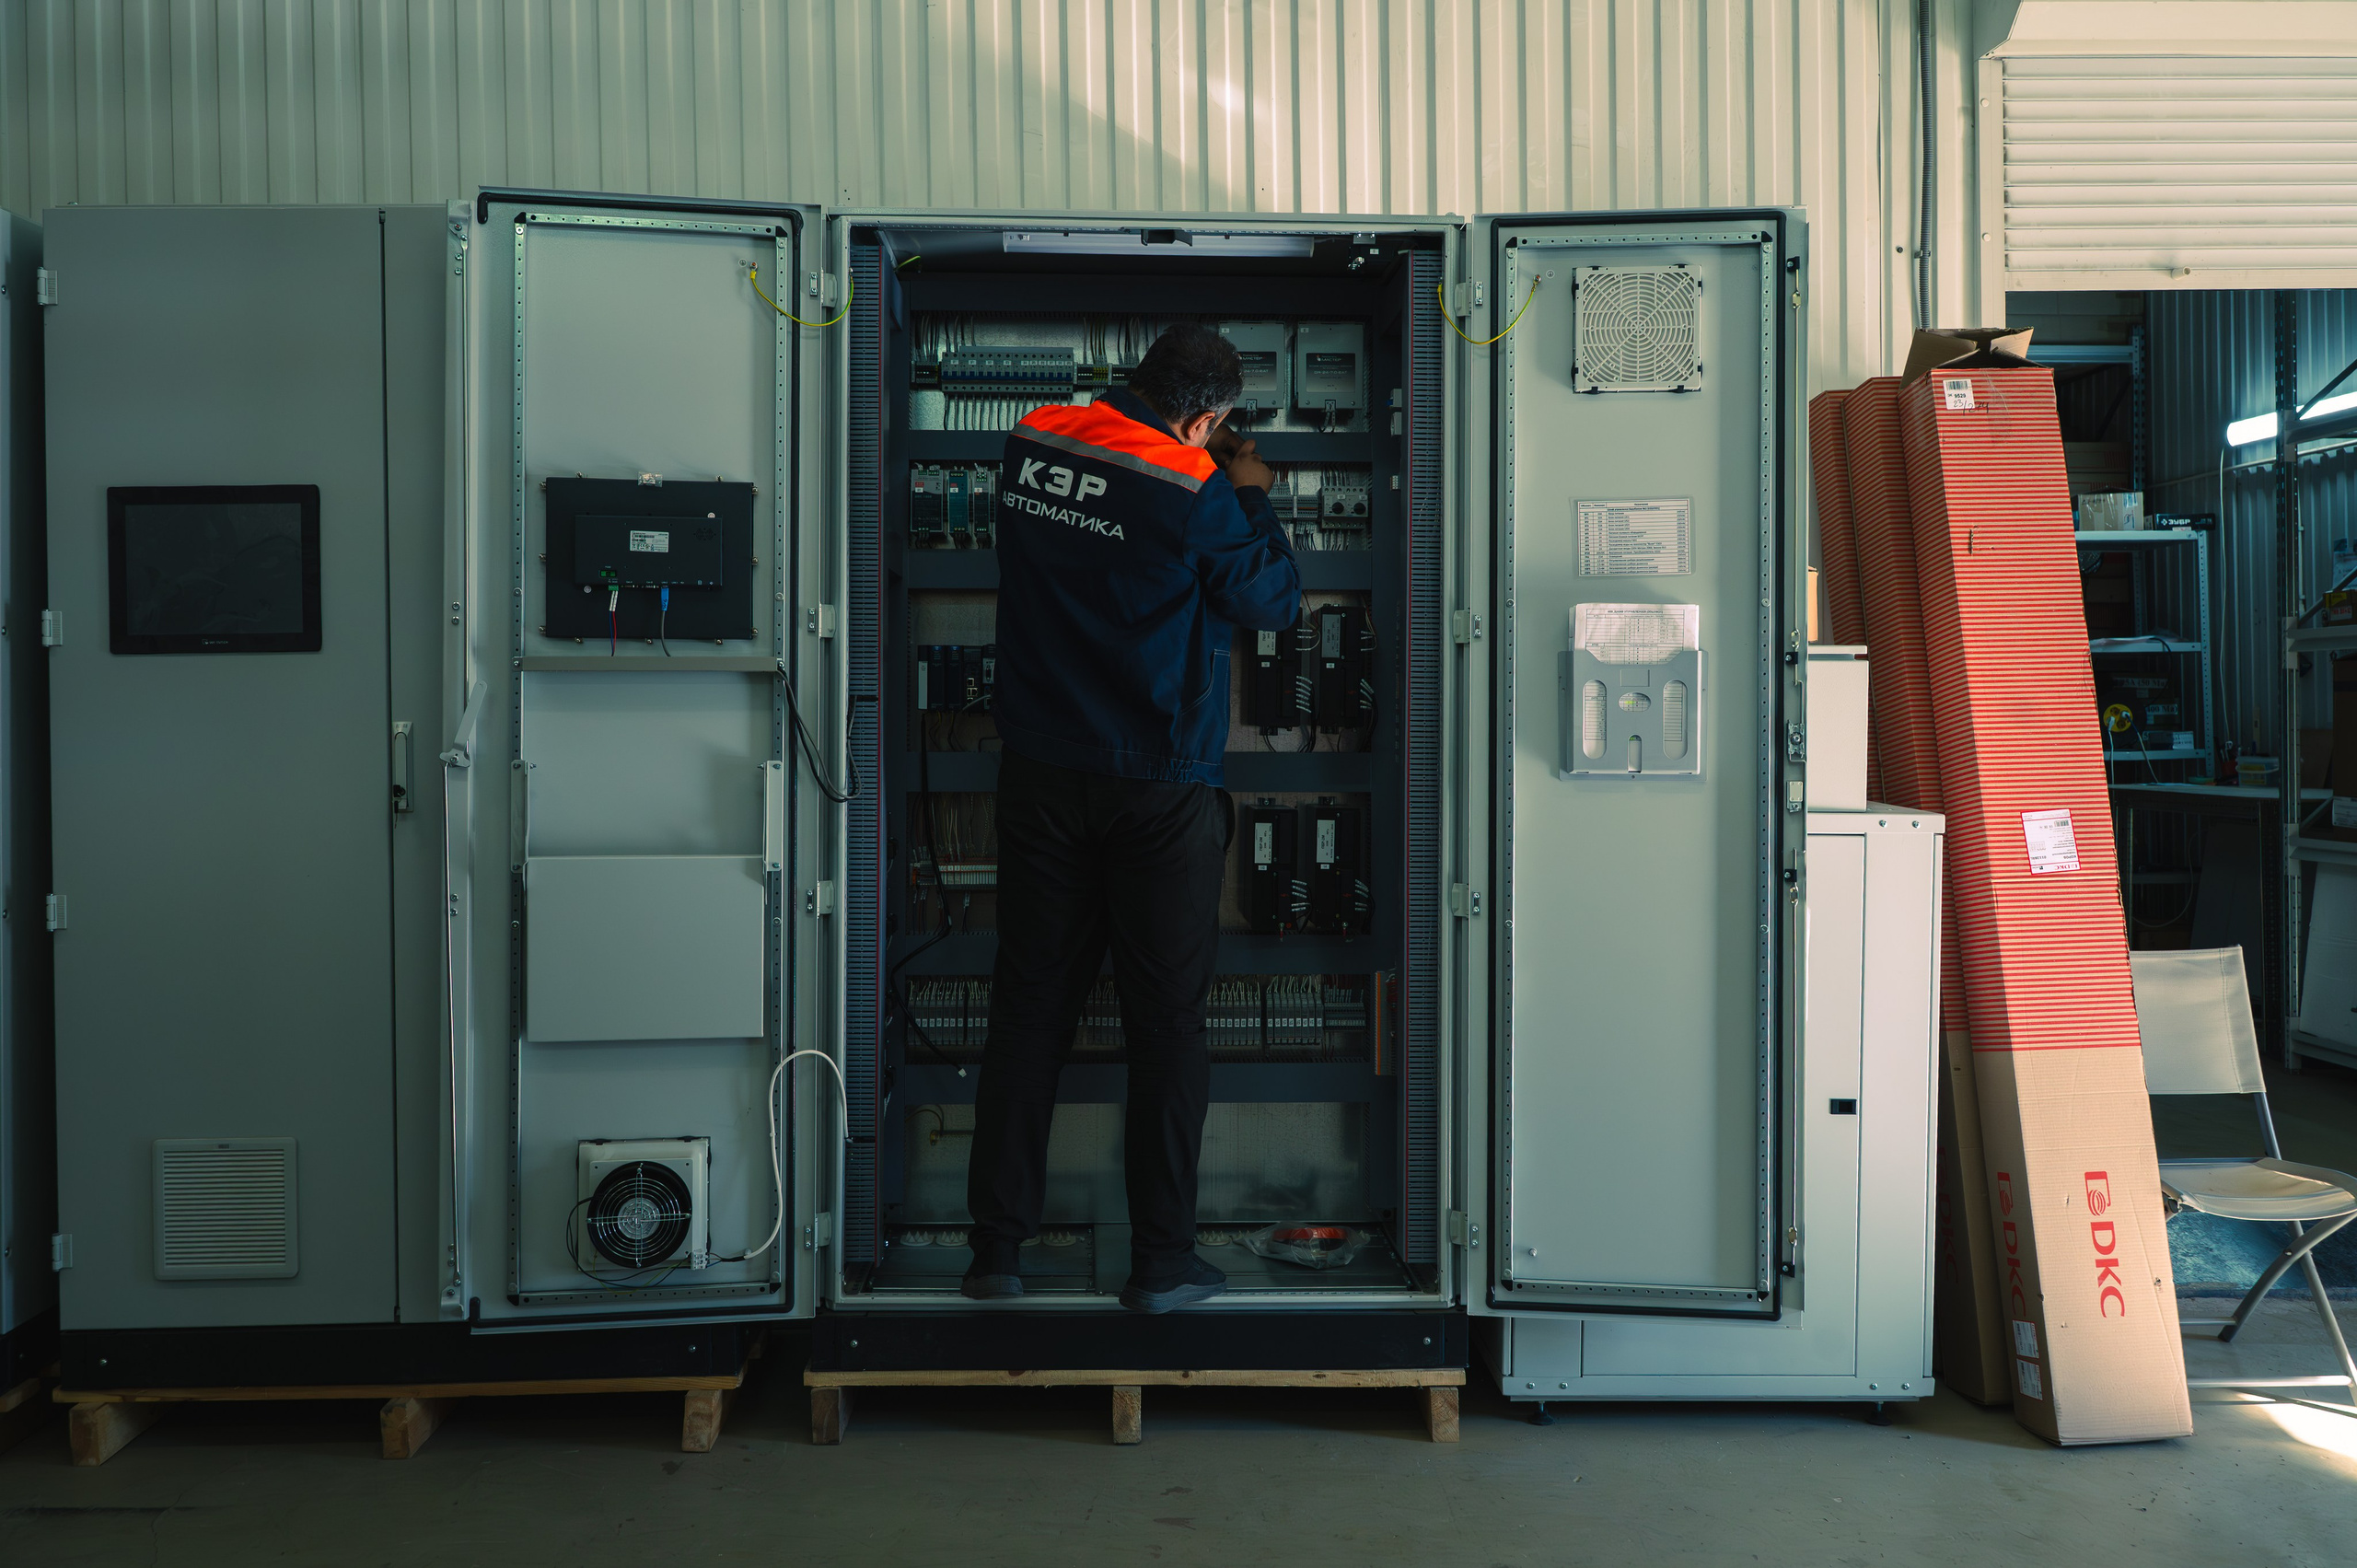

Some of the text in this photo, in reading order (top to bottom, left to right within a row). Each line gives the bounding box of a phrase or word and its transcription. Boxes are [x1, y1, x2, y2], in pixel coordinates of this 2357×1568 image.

[1003, 490, 1125, 541] АВТОМАТИКА
[1017, 457, 1109, 503] КЭР
[2002, 1221, 2027, 1318] DKC
[2089, 1220, 2126, 1318] DKC
